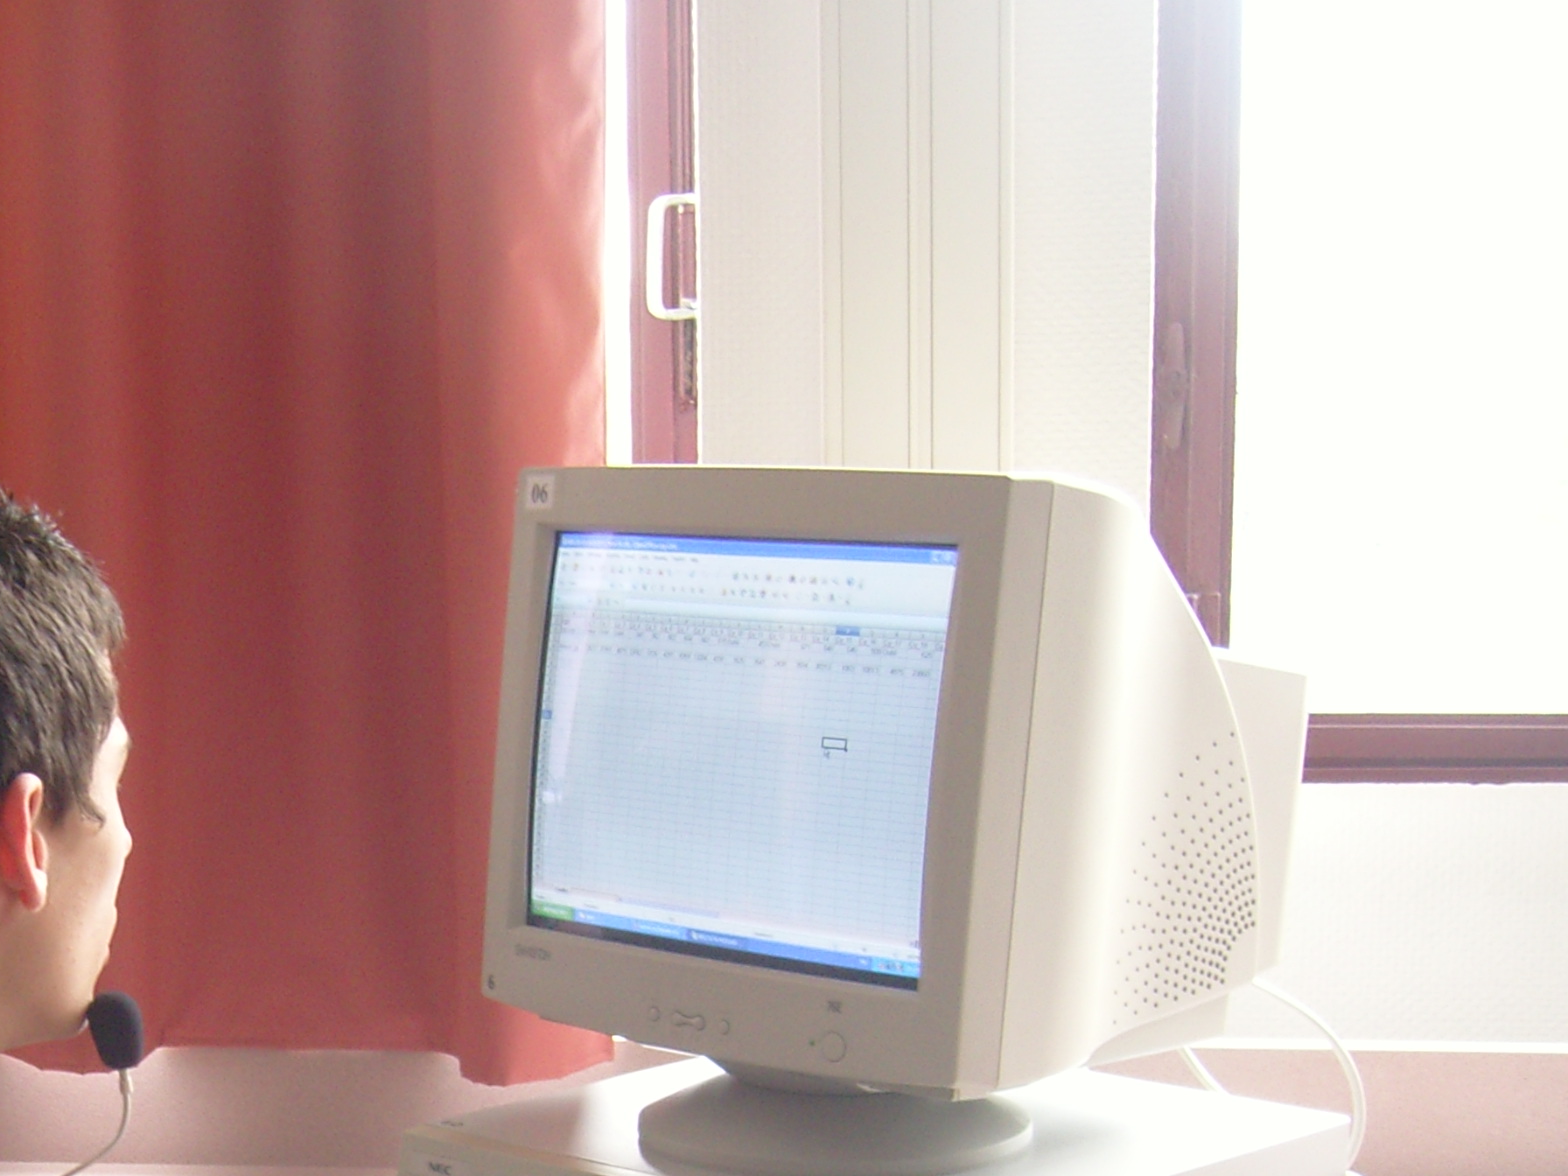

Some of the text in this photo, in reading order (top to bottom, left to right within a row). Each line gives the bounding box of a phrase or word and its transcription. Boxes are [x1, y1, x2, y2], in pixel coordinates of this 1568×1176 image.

[531, 482, 549, 504] 06
[487, 974, 496, 990] 6
[428, 1161, 452, 1176] NEC
